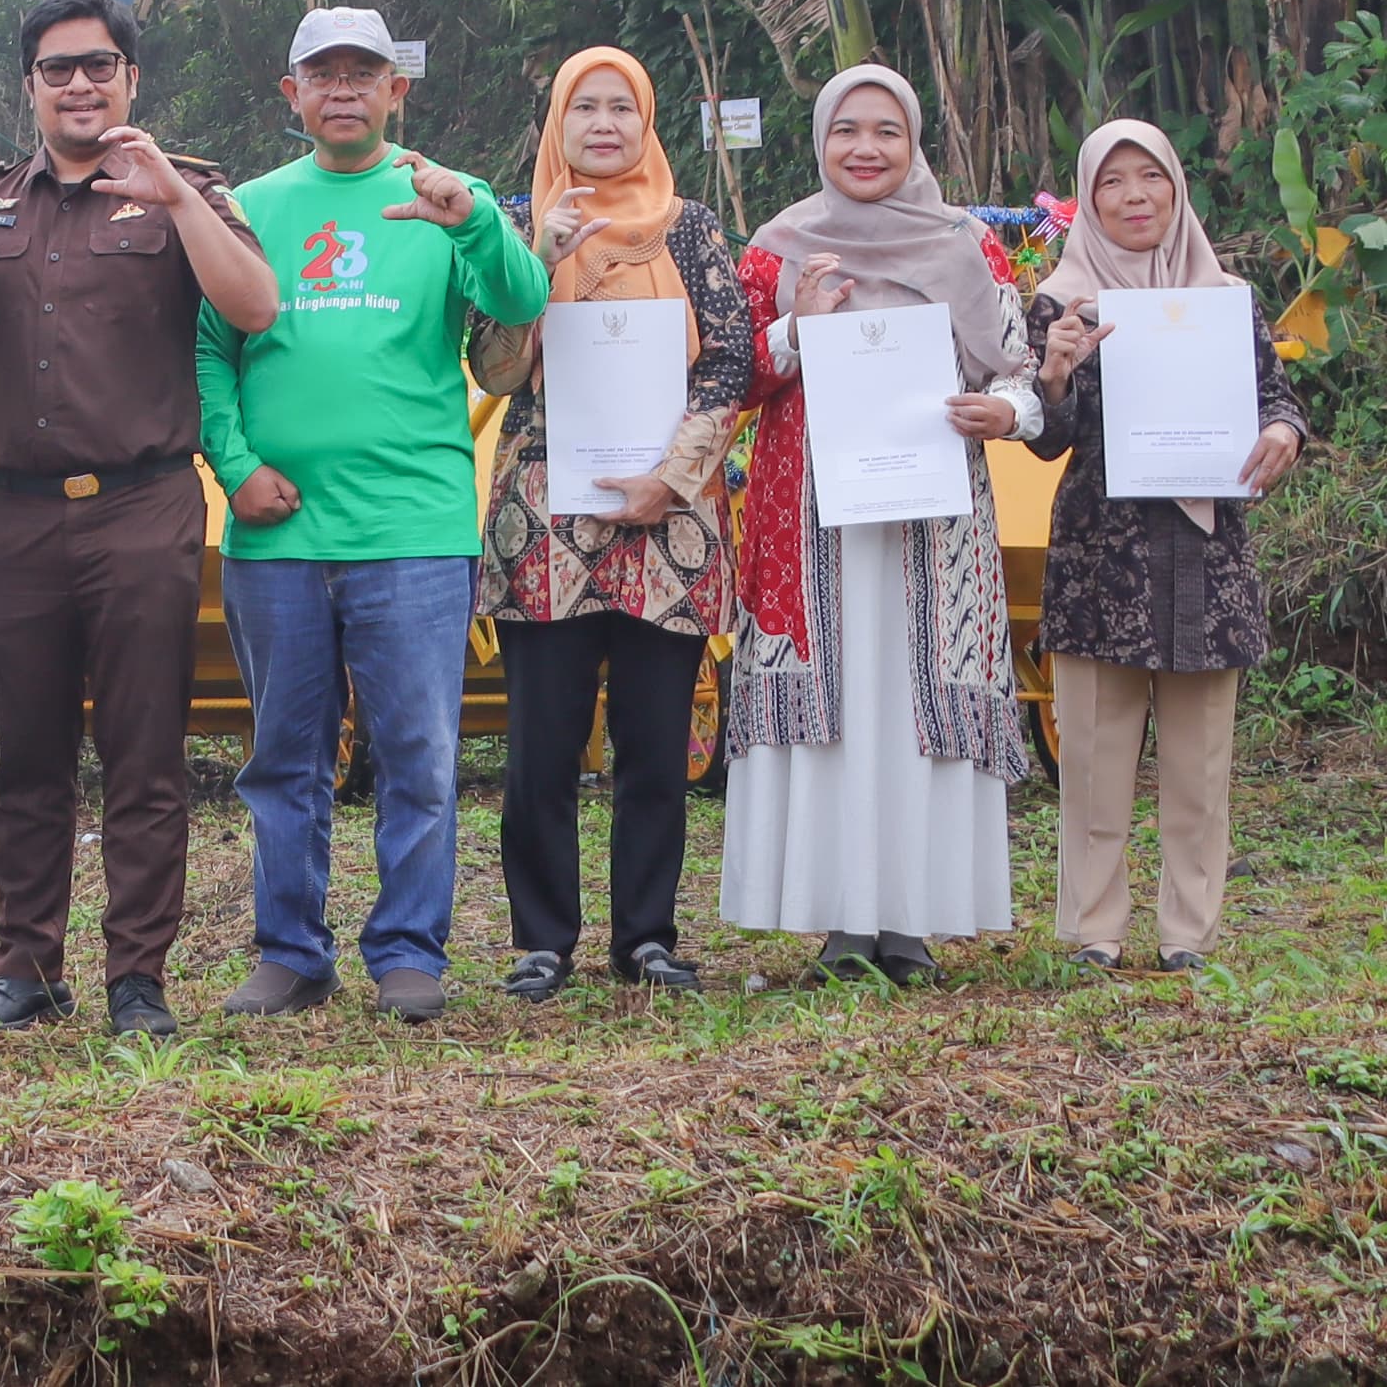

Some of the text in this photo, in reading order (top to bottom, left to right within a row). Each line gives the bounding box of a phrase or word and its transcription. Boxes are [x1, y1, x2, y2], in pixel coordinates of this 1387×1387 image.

[300, 225, 368, 279] 23
[295, 296, 362, 312] Lingkungan
[365, 293, 401, 313] Hidup
